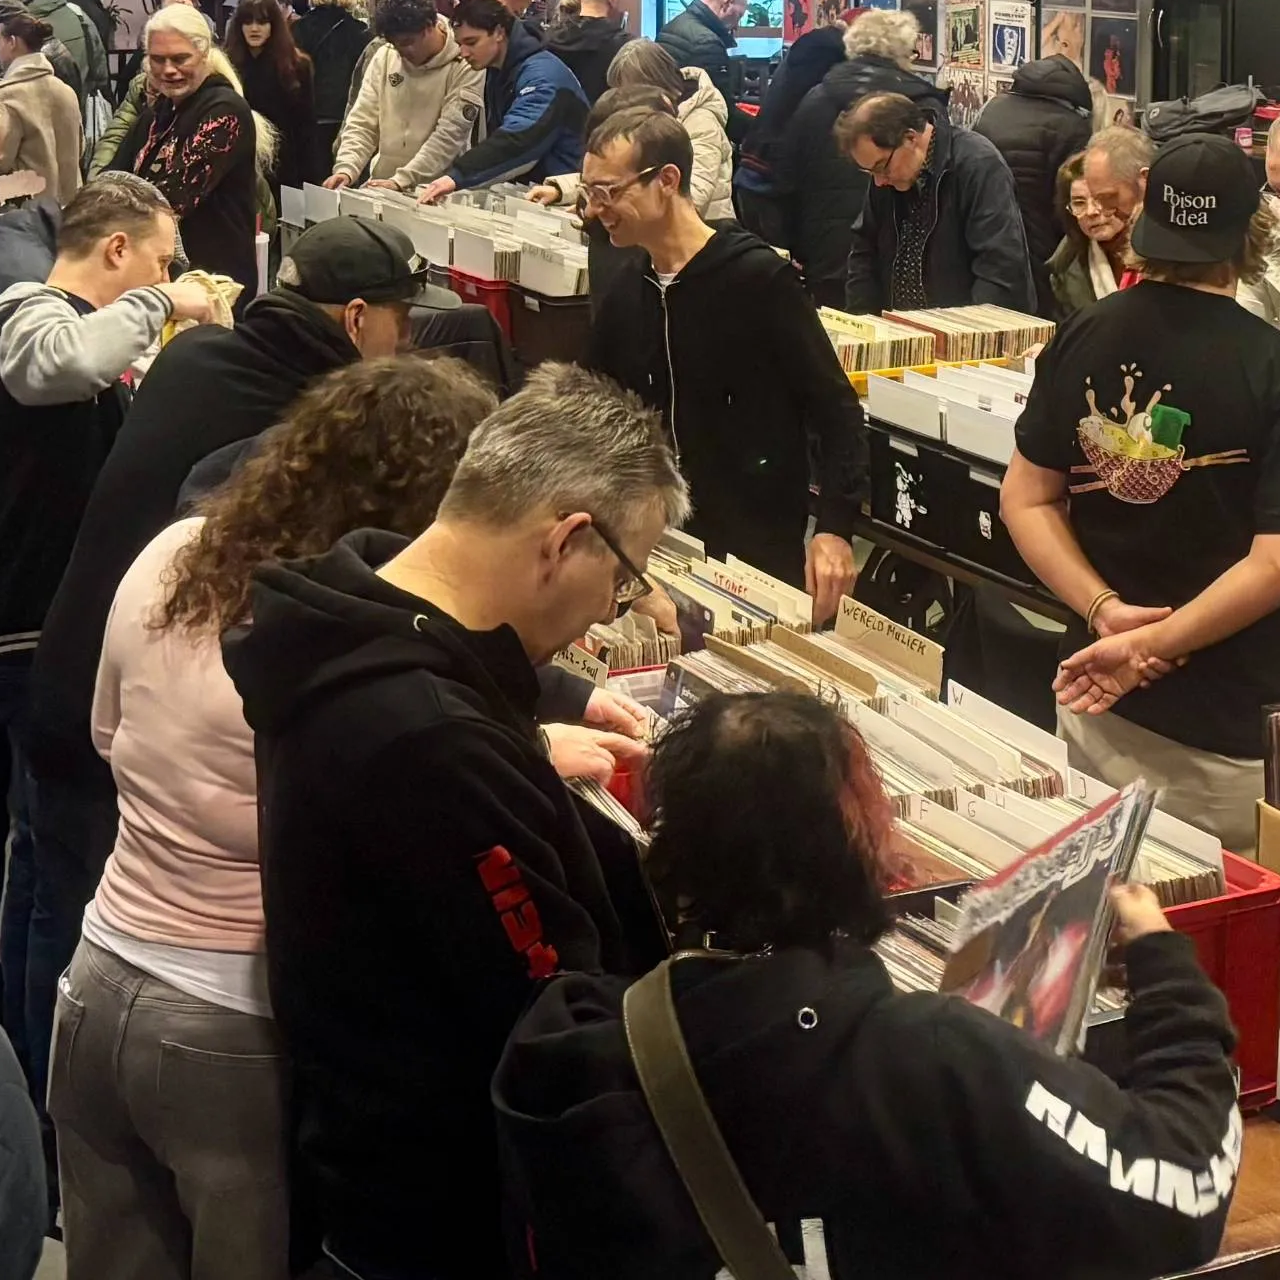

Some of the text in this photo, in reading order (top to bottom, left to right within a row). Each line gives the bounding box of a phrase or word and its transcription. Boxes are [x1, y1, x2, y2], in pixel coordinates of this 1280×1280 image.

[1163, 184, 1216, 209] Poison
[1170, 205, 1208, 226] Idea
[842, 600, 884, 632] WERELD
[581, 659, 599, 681] Soul
[952, 687, 964, 706] W
[919, 799, 931, 821] F
